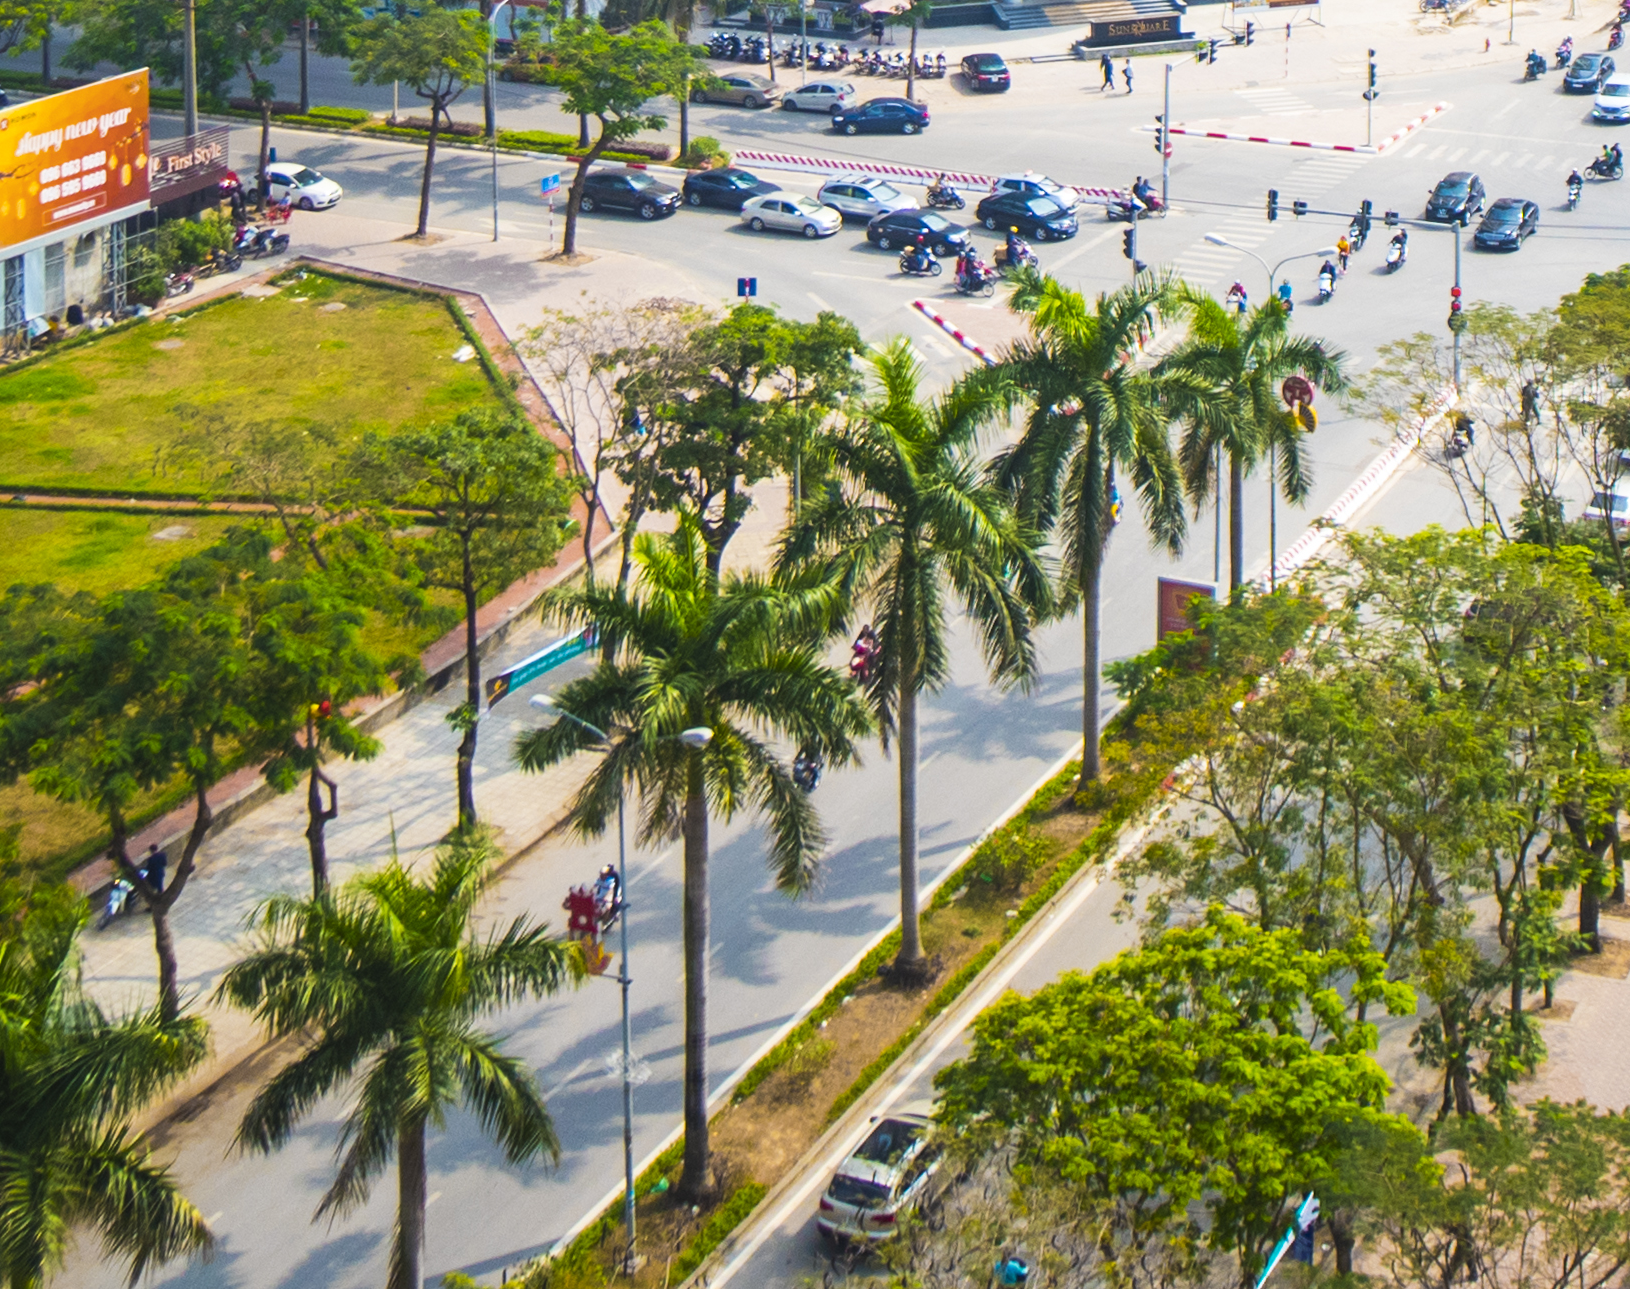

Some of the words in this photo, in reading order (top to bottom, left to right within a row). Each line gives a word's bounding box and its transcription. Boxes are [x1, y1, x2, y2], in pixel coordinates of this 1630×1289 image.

[15, 127, 63, 157] Happy
[64, 117, 98, 141] new
[98, 107, 132, 138] year
[167, 153, 193, 174] First
[194, 142, 222, 165] Style
